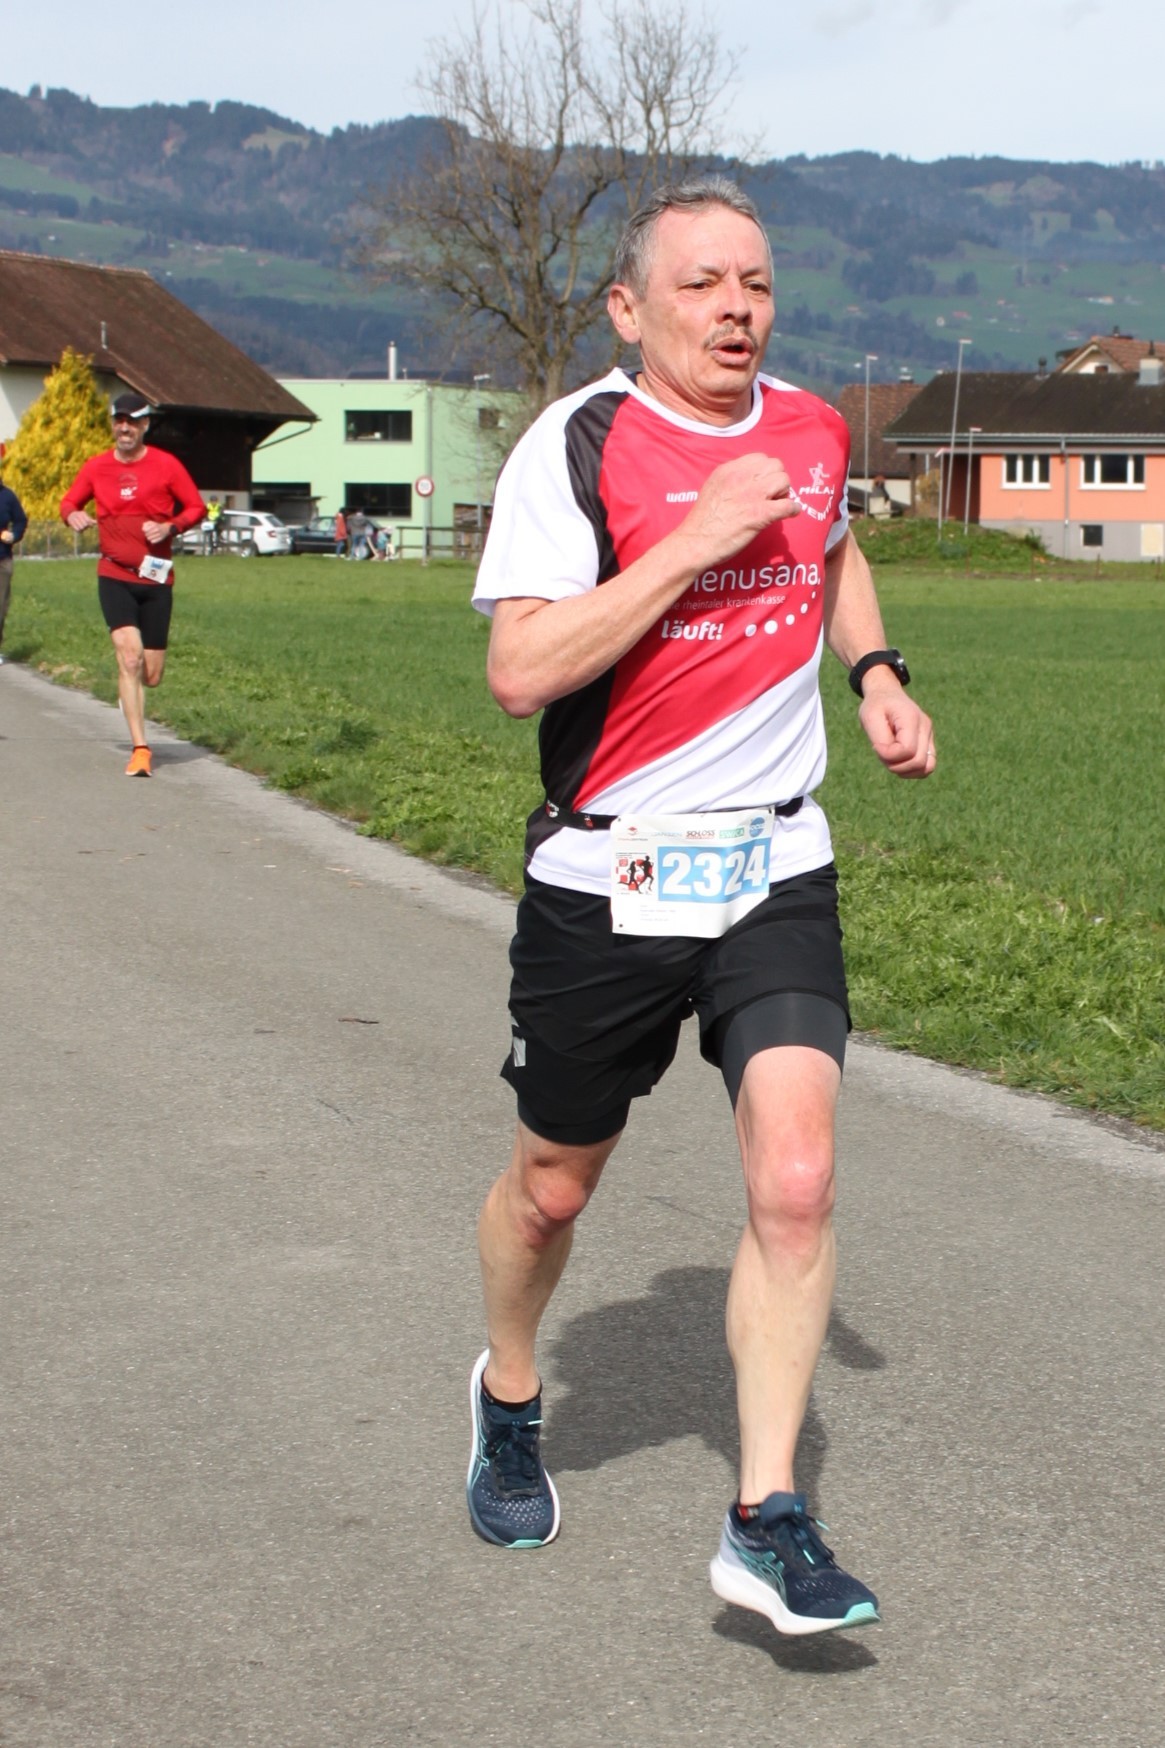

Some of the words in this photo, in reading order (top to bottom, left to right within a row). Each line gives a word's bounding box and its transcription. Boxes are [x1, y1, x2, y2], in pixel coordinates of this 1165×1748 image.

[727, 594, 786, 608] krankenkasse
[661, 619, 724, 641] läuft!
[662, 845, 767, 897] 2324
